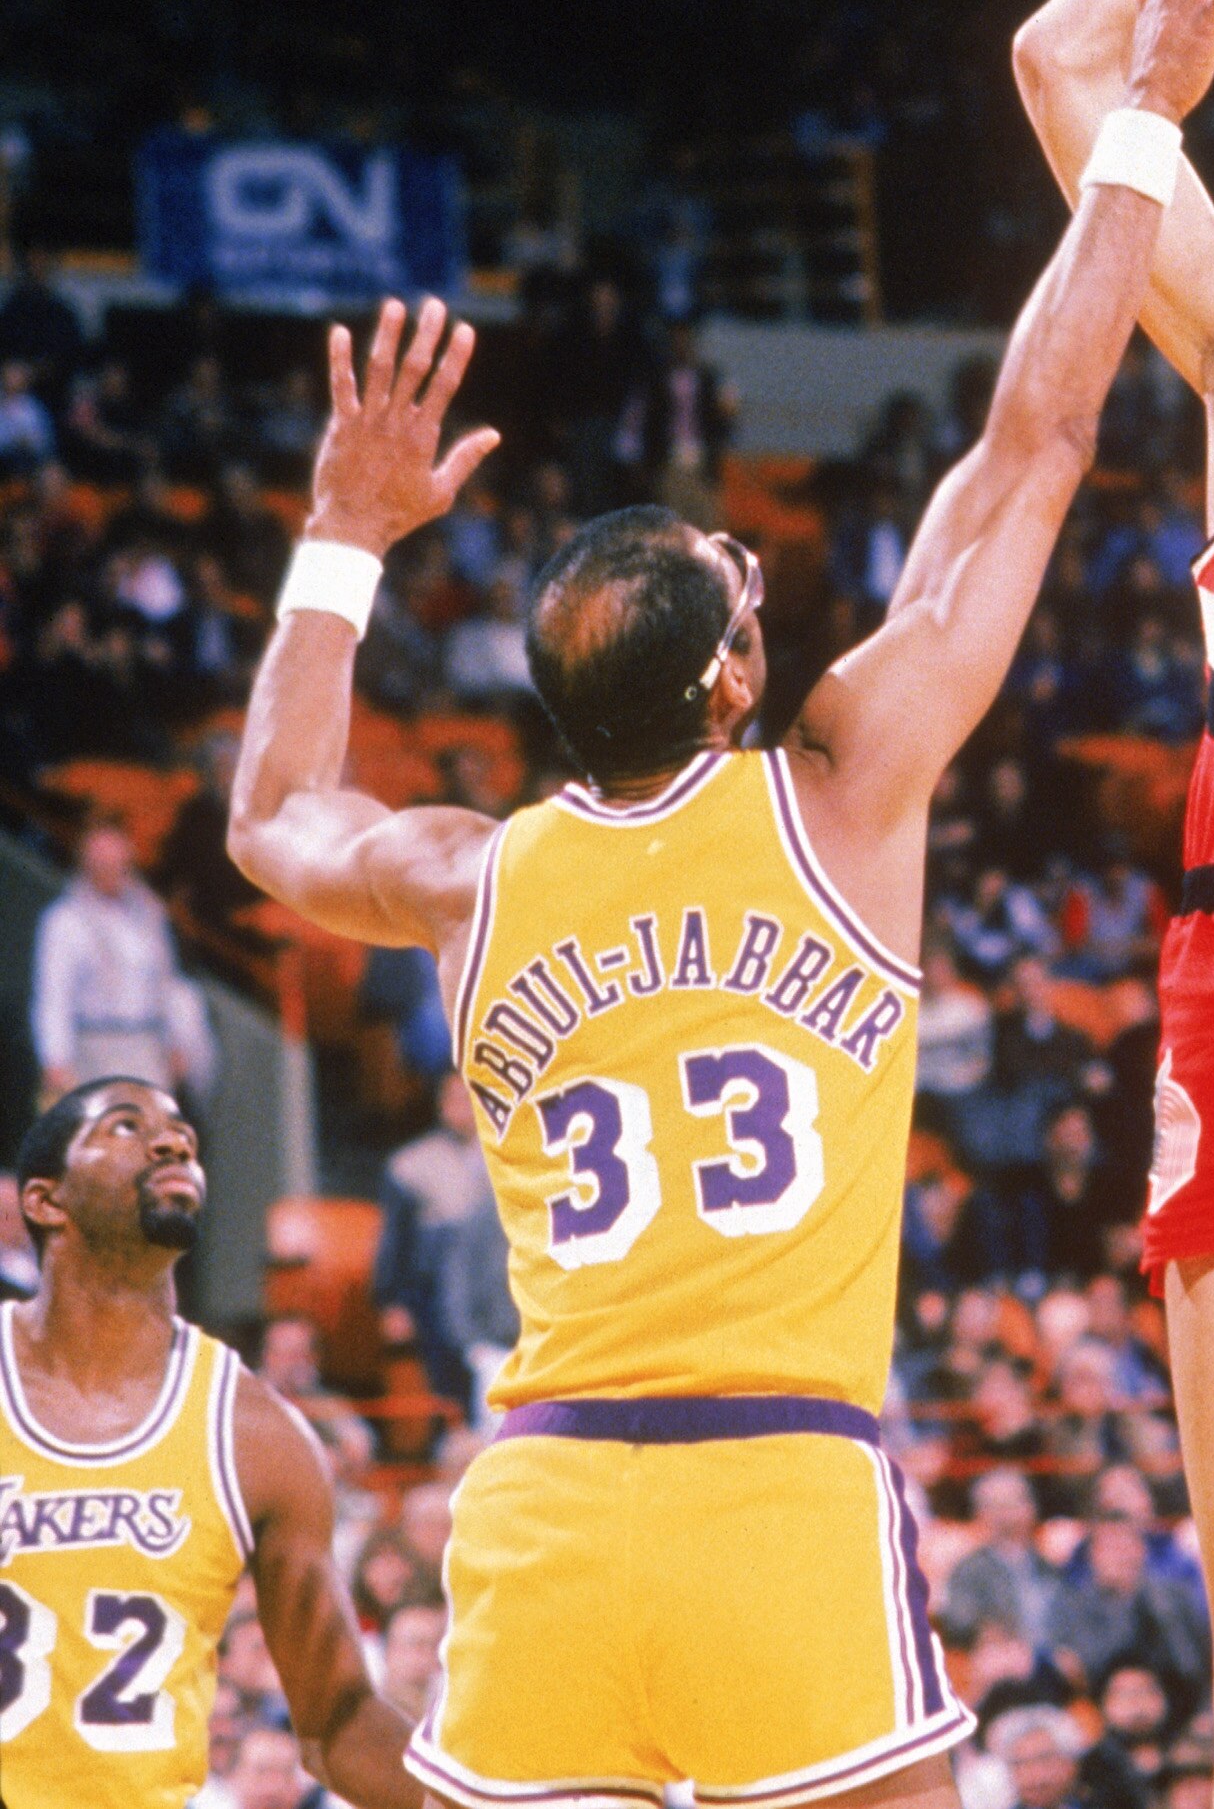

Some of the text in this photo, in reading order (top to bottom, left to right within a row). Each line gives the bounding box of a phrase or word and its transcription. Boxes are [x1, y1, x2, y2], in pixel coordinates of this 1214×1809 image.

[467, 905, 905, 1144] ABDUL-JABBAR
[530, 1042, 825, 1270] 33
[0, 1475, 191, 1567] AKERS
